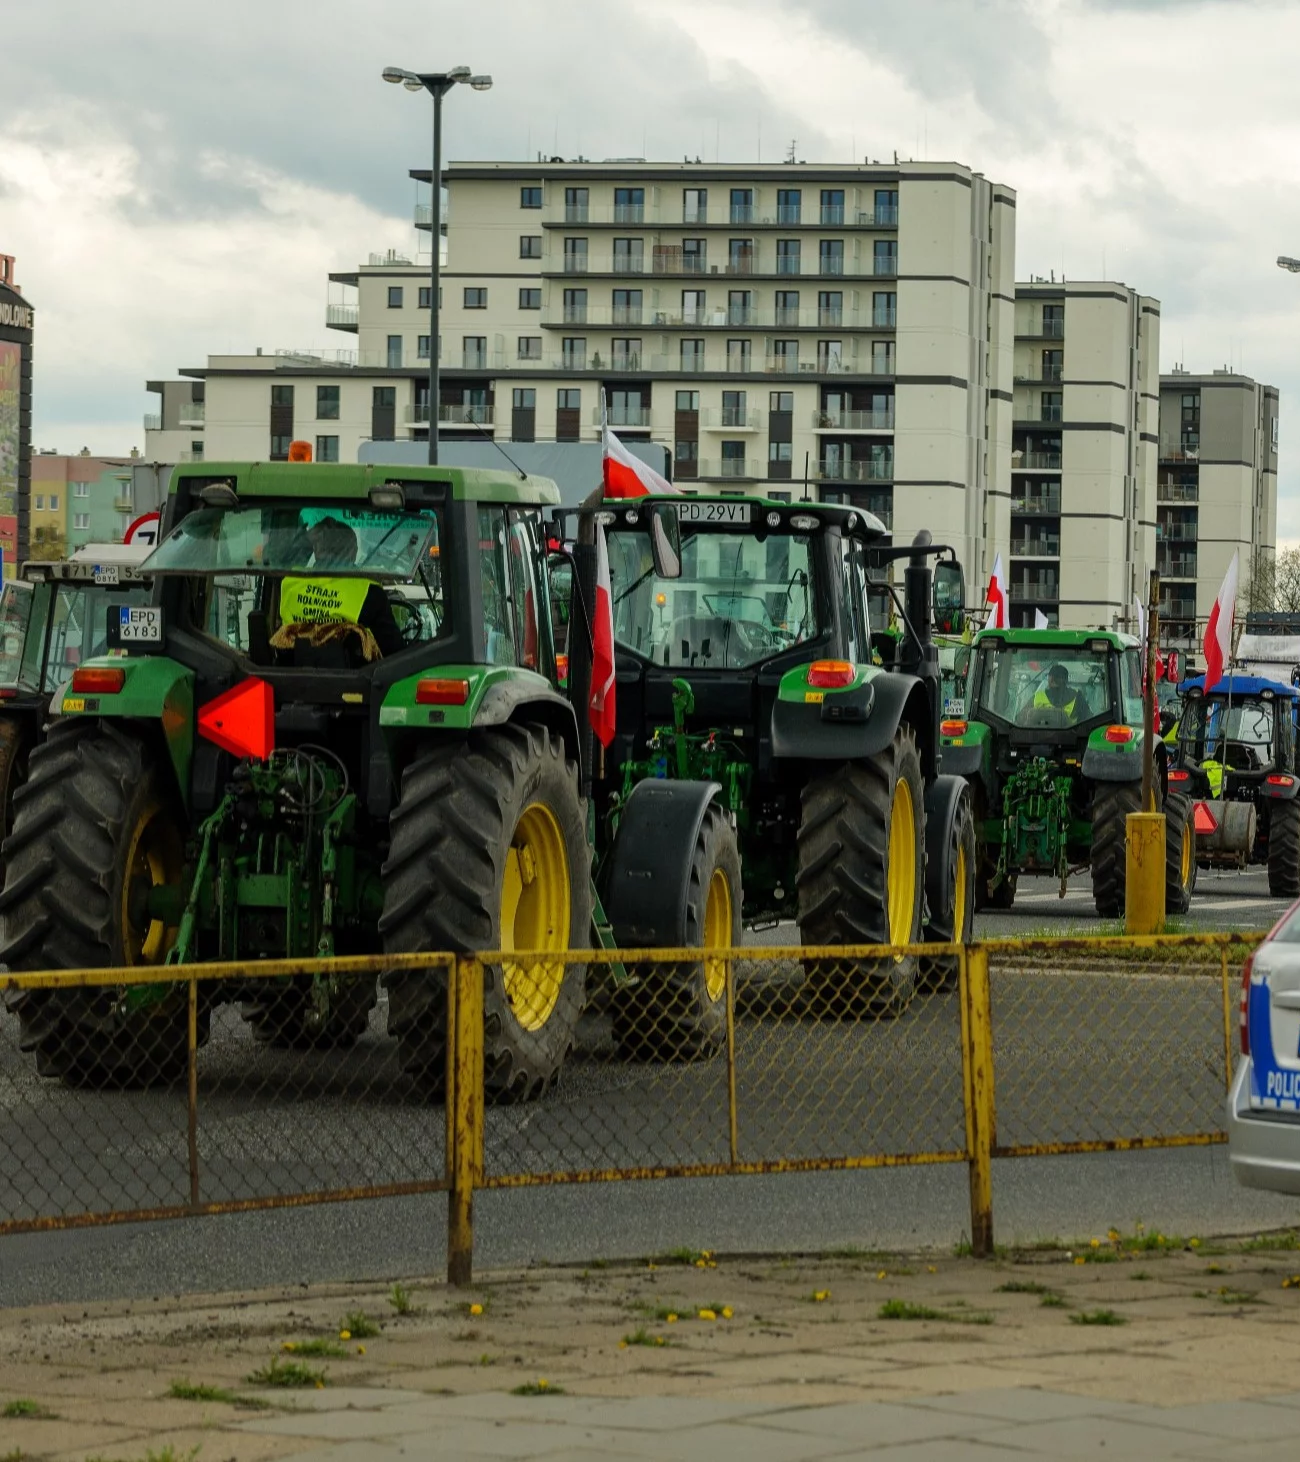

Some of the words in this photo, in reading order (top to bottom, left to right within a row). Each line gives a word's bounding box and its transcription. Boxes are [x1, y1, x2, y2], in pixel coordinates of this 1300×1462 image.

[676, 504, 700, 519] PD
[707, 505, 745, 520] 29V1
[100, 565, 116, 574] EPD
[305, 584, 339, 598] STRAJK
[131, 611, 155, 622] EPD
[303, 607, 330, 617] GMINA
[123, 625, 158, 637] 6Y83
